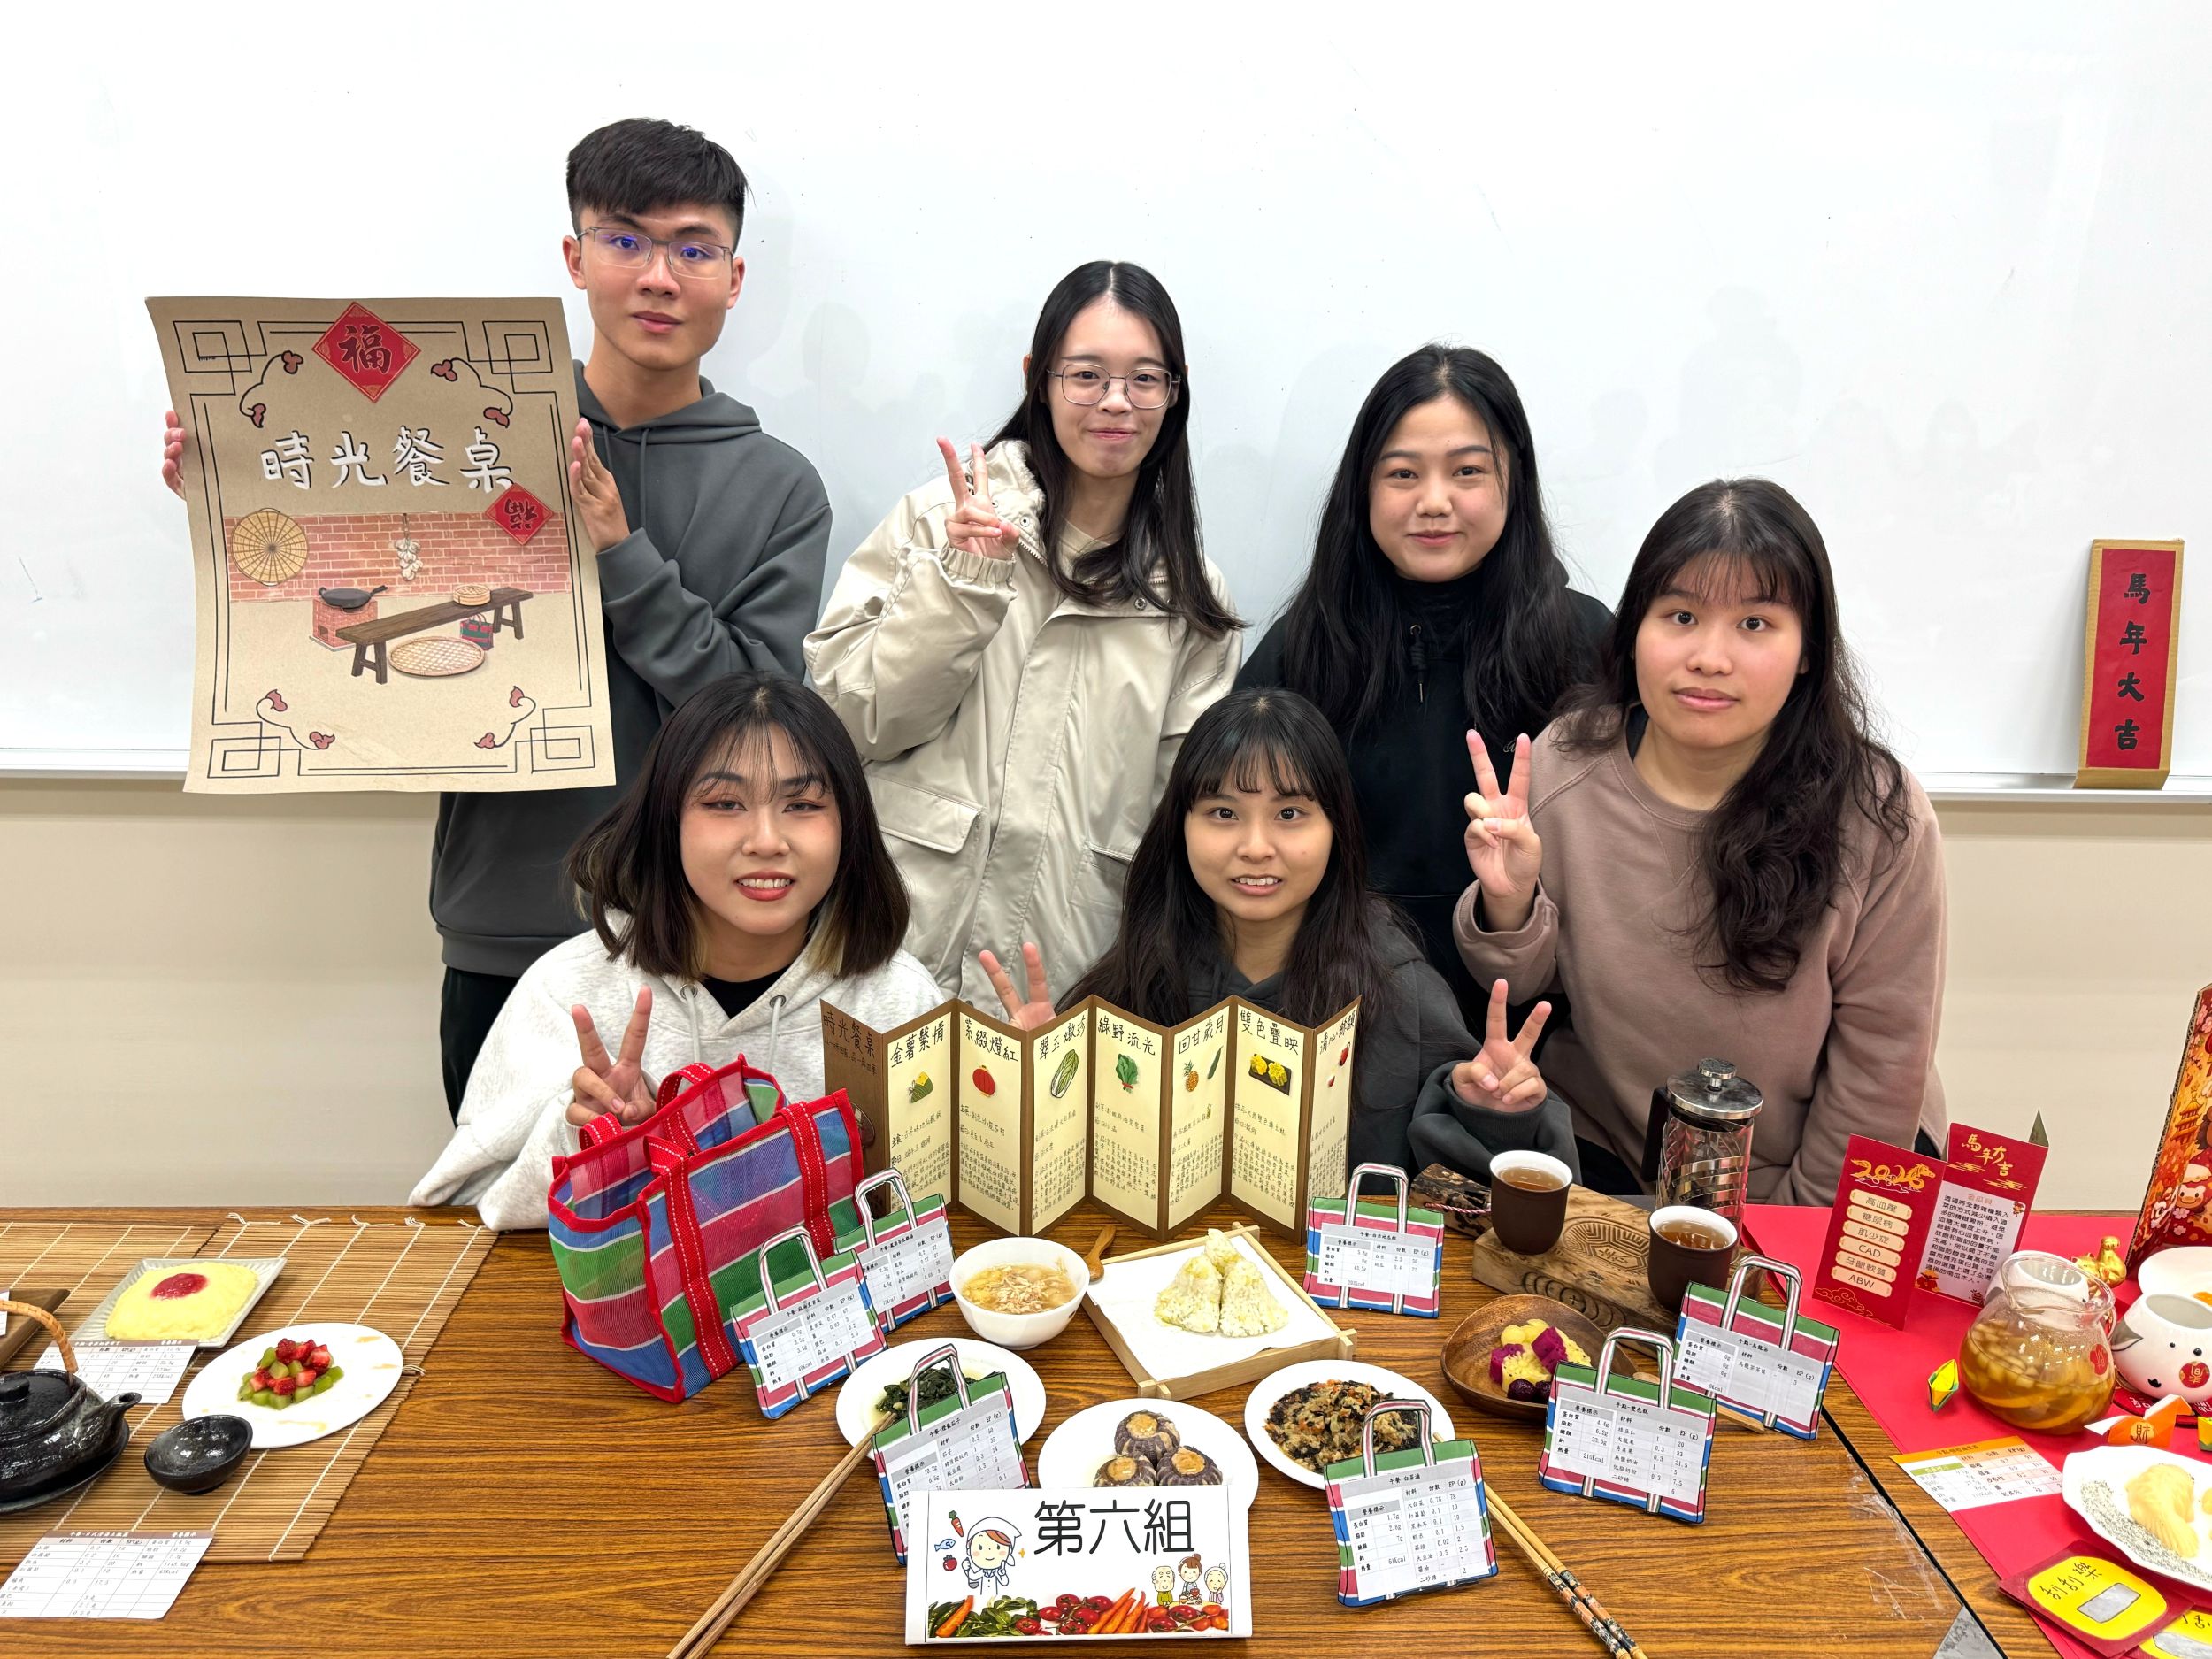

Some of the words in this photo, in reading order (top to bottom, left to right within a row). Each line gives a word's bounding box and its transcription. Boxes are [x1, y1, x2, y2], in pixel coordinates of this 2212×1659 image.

[338, 325, 393, 373] 福
[260, 426, 516, 494] 時光餐桌
[2114, 573, 2150, 750] 馬年大吉
[824, 1011, 875, 1059] 時光餐桌
[1098, 1015, 1155, 1056] 綠野流光
[1179, 1015, 1223, 1054] 回甘歲月
[1240, 1010, 1298, 1055] 雙色疊映
[1865, 1196, 1898, 1213] 高血壓
[1862, 1212, 1893, 1229] 糖尿病
[1857, 1227, 1889, 1244] 肌少症
[1858, 1244, 1881, 1257] CAD
[1848, 1274, 1875, 1288] ABW
[1562, 1410, 1579, 1420] 蛋白質
[1574, 1405, 1598, 1416] 營養標示
[2136, 1424, 2151, 1445] 財
[896, 1479, 911, 1489] 蛋白質
[1405, 1487, 1417, 1496] 材料
[1362, 1504, 1386, 1516] 營養標示
[1406, 1499, 1425, 1509] 大白菜
[1033, 1498, 1194, 1555] 第六組
[1353, 1518, 1368, 1529] 蛋白質
[2039, 1562, 2102, 1600] 刮刮樂
